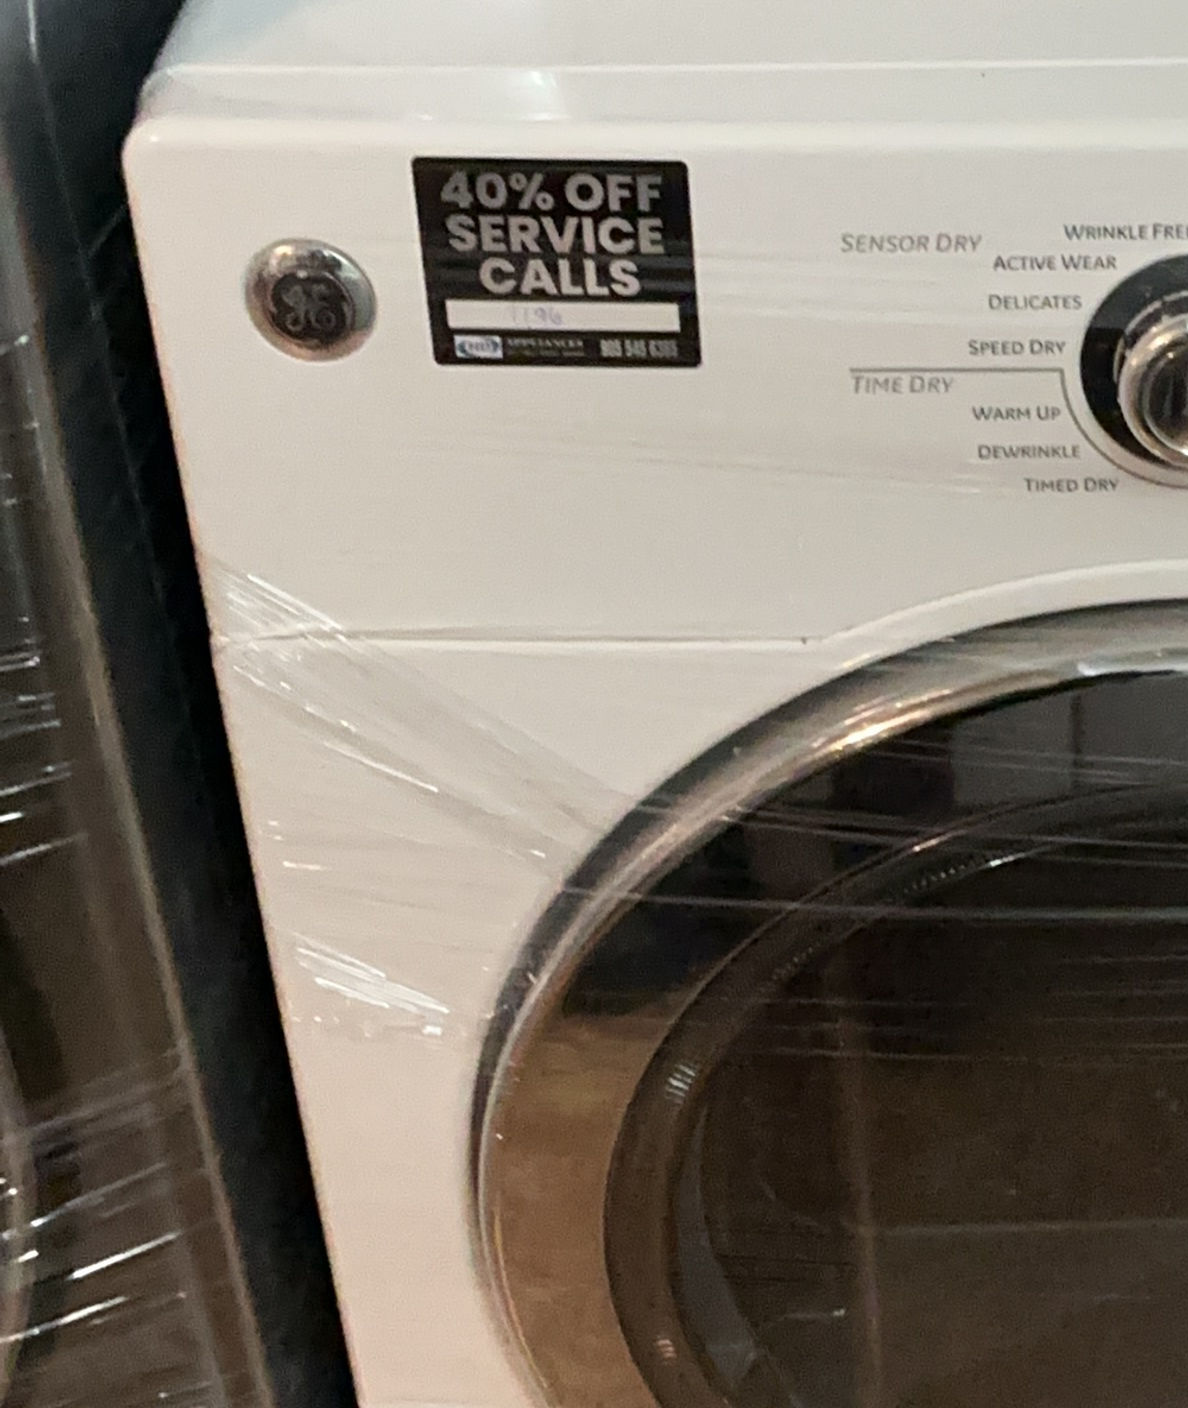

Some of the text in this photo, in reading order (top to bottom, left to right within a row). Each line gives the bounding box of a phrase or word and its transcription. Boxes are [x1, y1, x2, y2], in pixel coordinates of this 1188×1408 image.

[440, 172, 662, 212] 40% OFF
[446, 214, 665, 254] SERVICE
[1064, 224, 1148, 241] WRINKLE
[840, 233, 983, 254] SENSOR DRY
[993, 254, 1118, 272] ACTIVE WEAR
[479, 258, 641, 296] CALLS
[988, 294, 1082, 311] DELICATES
[968, 339, 1066, 356] SPEED DRY
[852, 375, 954, 395] TIME DRY
[972, 405, 1061, 421] WARM UP
[977, 444, 1080, 461] DEWRINKLE
[1025, 476, 1118, 493] TIMED DRY
